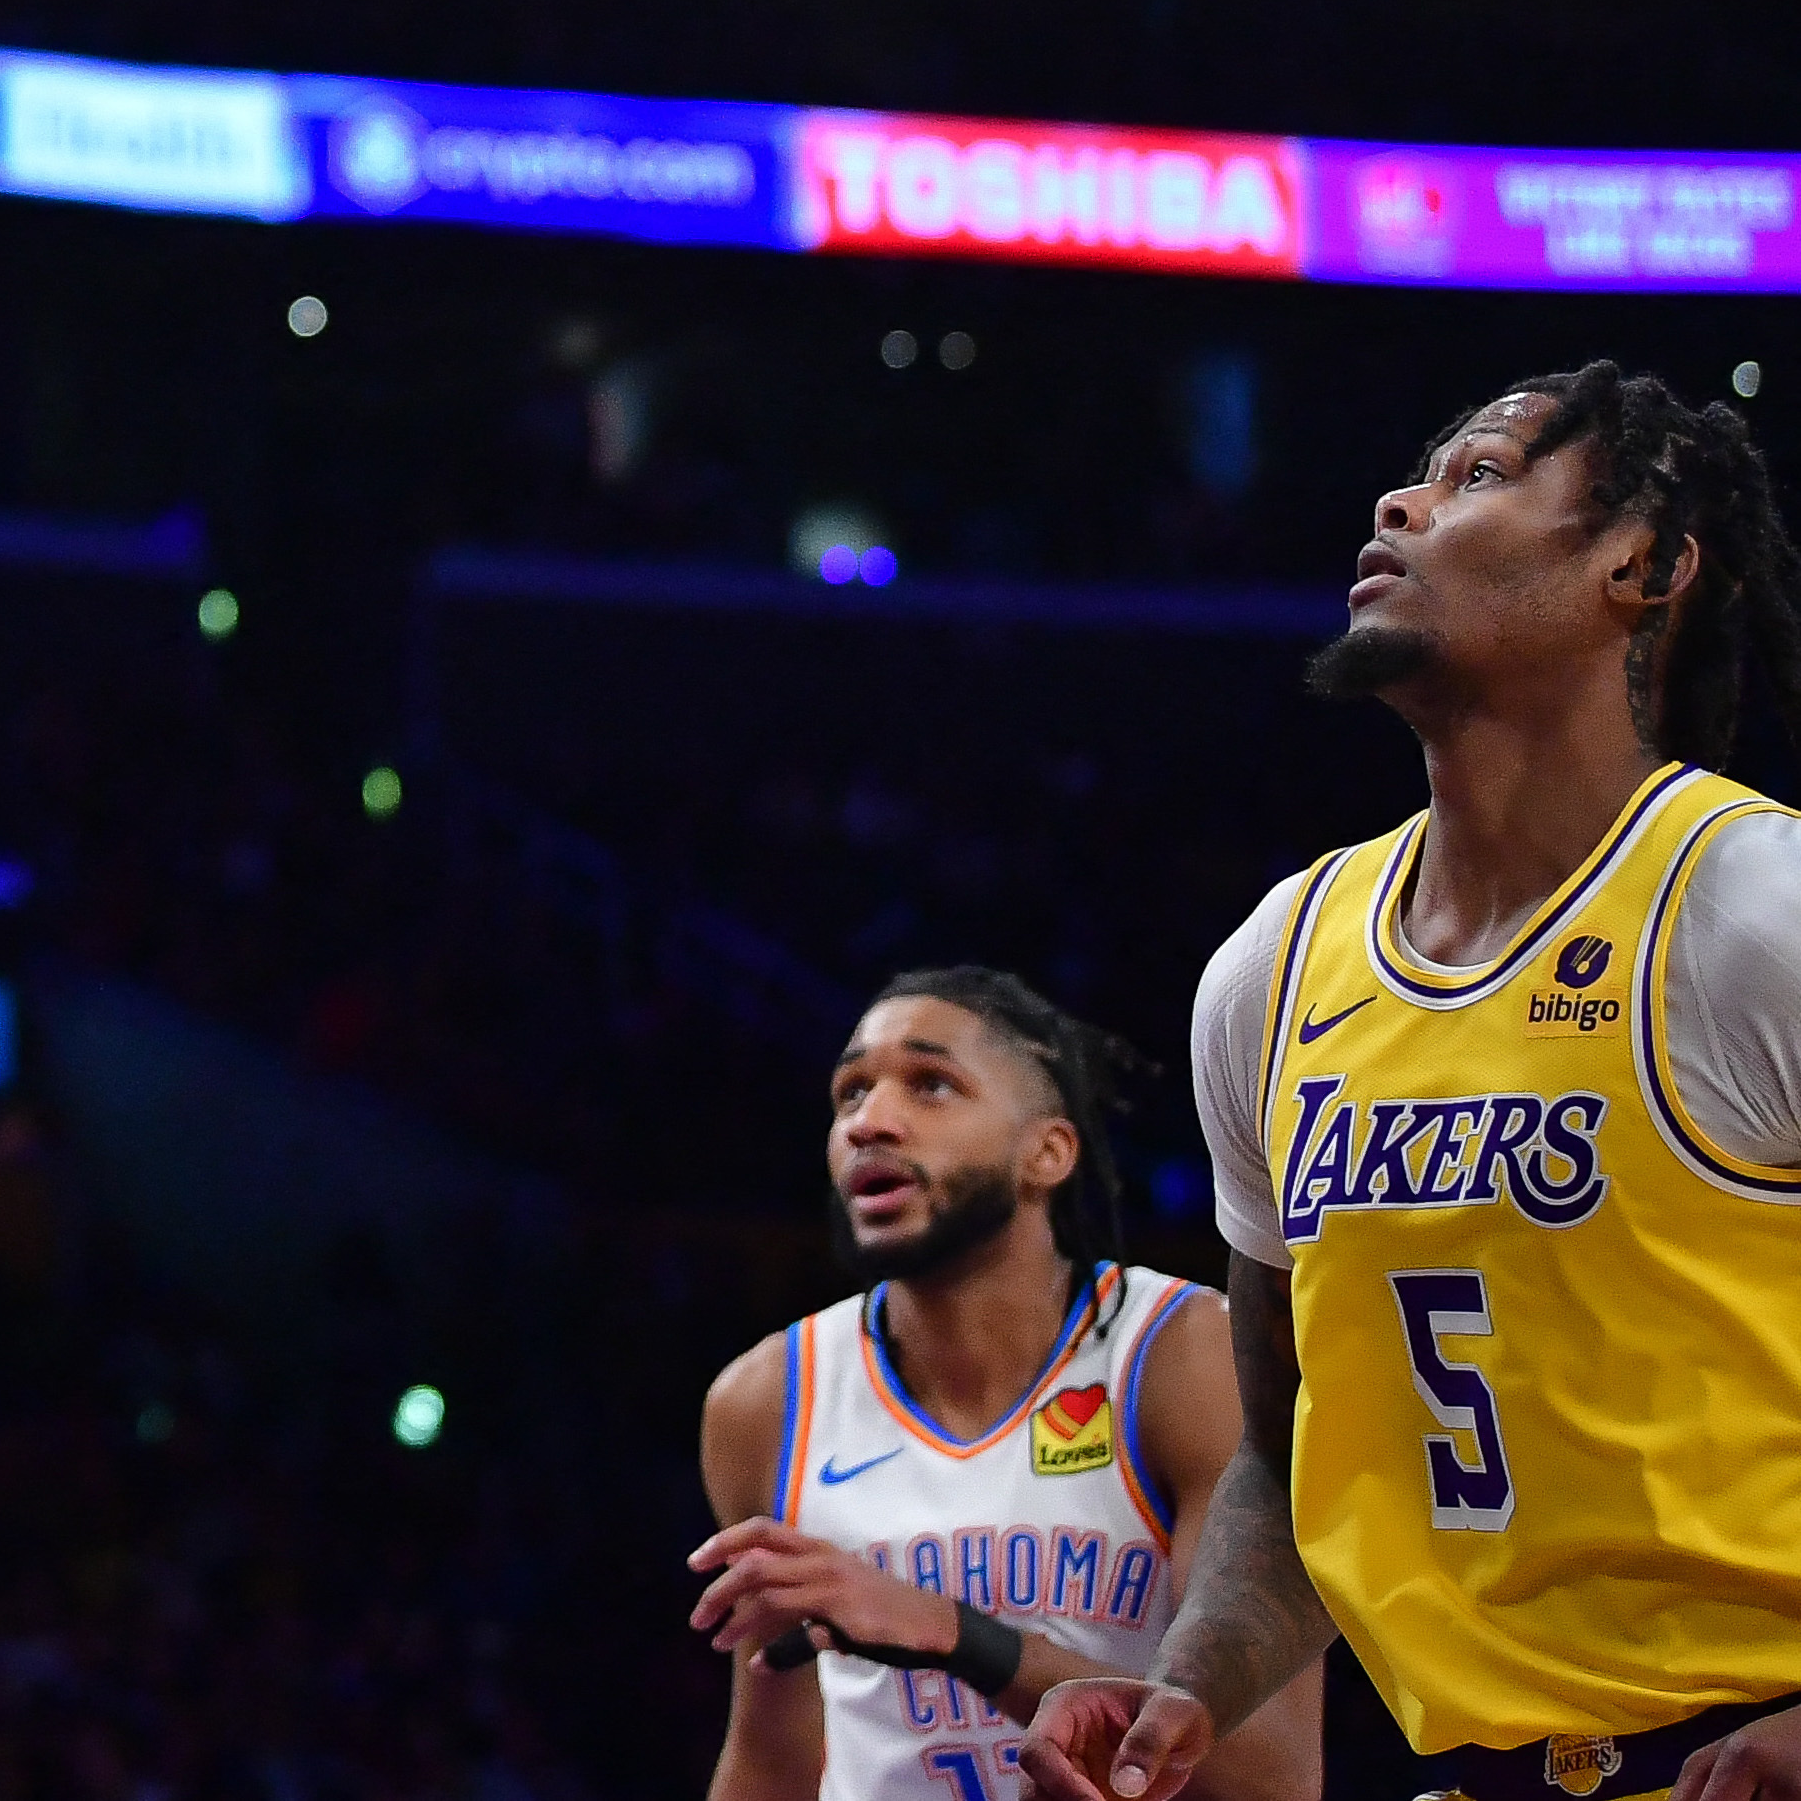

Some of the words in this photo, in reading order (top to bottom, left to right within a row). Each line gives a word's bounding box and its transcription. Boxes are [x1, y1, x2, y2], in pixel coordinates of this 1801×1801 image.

[425, 124, 747, 208] crypto.com
[825, 134, 1281, 256] TOSHIBA
[1528, 992, 1620, 1034] bibigo
[1282, 1072, 1609, 1246] LAKERS
[1386, 1268, 1514, 1533] 5
